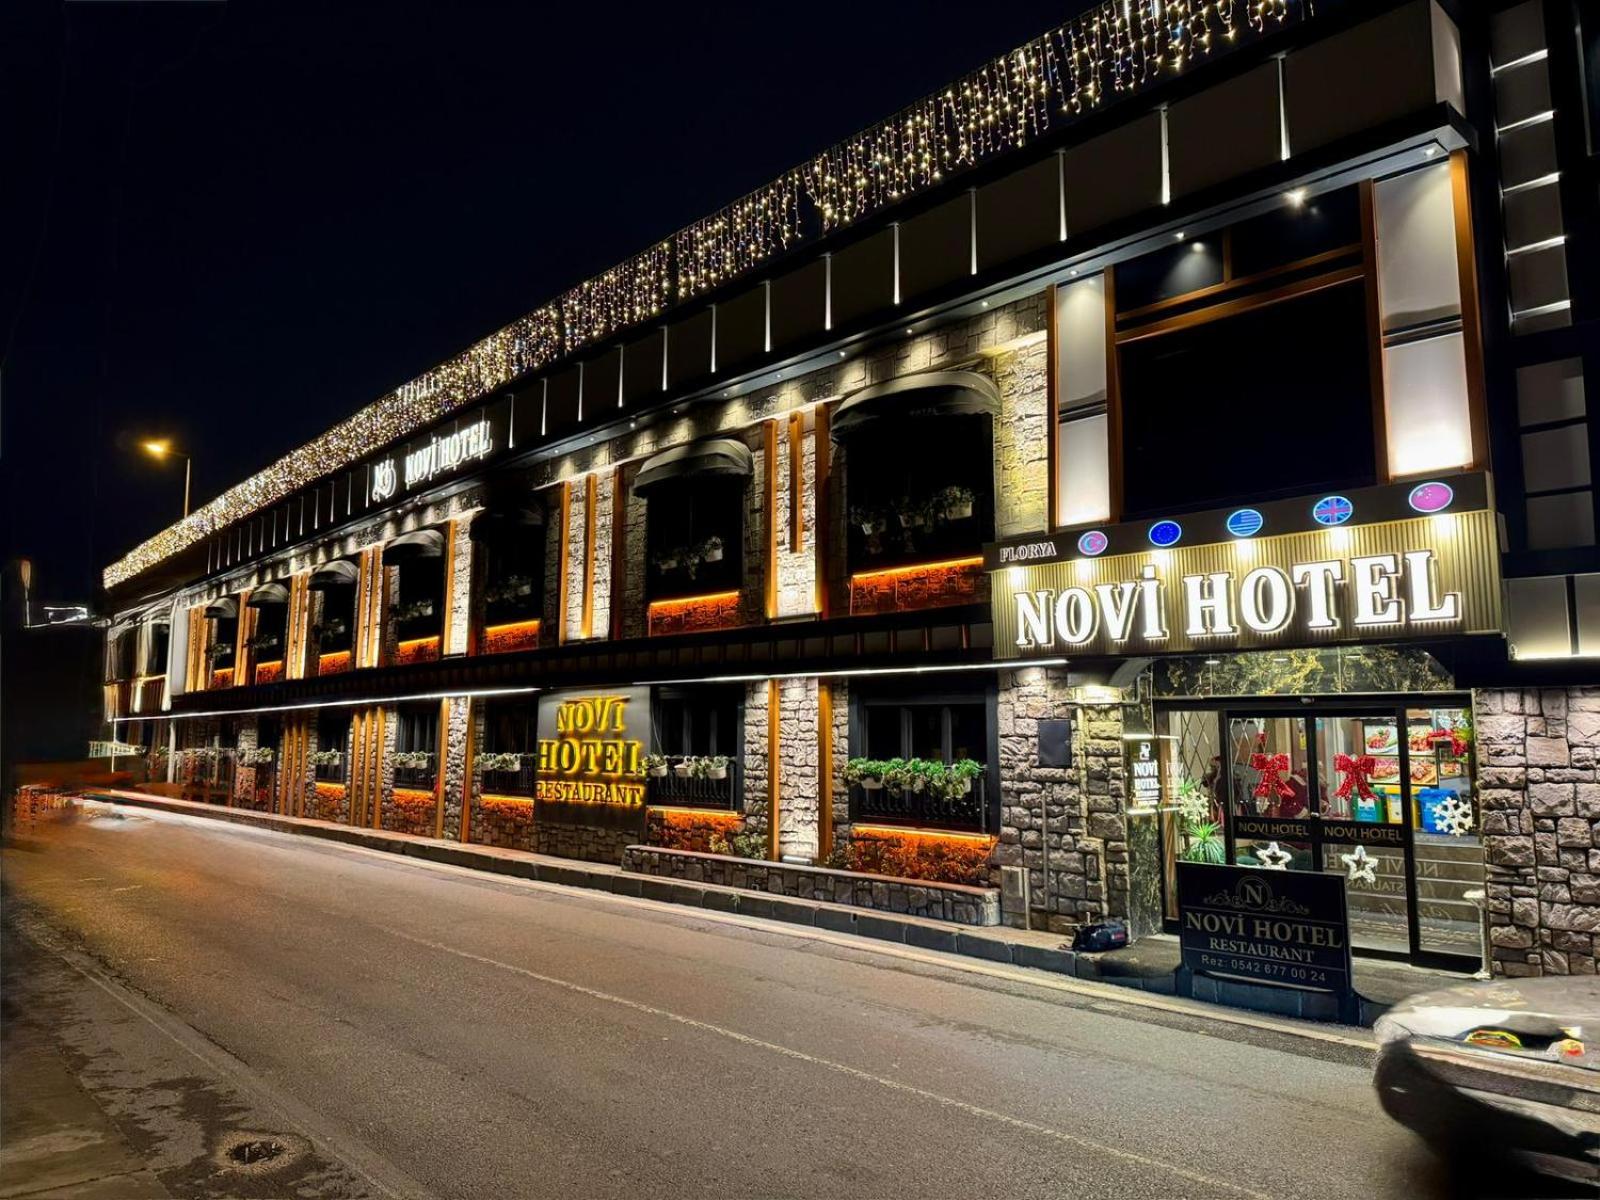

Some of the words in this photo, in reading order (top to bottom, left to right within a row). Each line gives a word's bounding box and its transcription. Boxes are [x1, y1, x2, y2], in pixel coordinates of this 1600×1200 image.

[441, 420, 493, 470] HOTEL
[1000, 542, 1057, 562] FLORYA
[1183, 549, 1462, 635] HOTEL
[538, 738, 645, 776] HOTEL
[535, 780, 643, 805] RESTAURANT
[1271, 823, 1310, 836] HOTEL
[1361, 828, 1403, 841] HOTEL
[1244, 883, 1263, 904] N
[1252, 919, 1343, 949] HOTEL
[1209, 937, 1315, 963] RESTAURANT
[1231, 959, 1261, 973] 0542
[1264, 963, 1287, 975] 677
[1291, 967, 1307, 979] 00
[1311, 970, 1326, 982] 24
